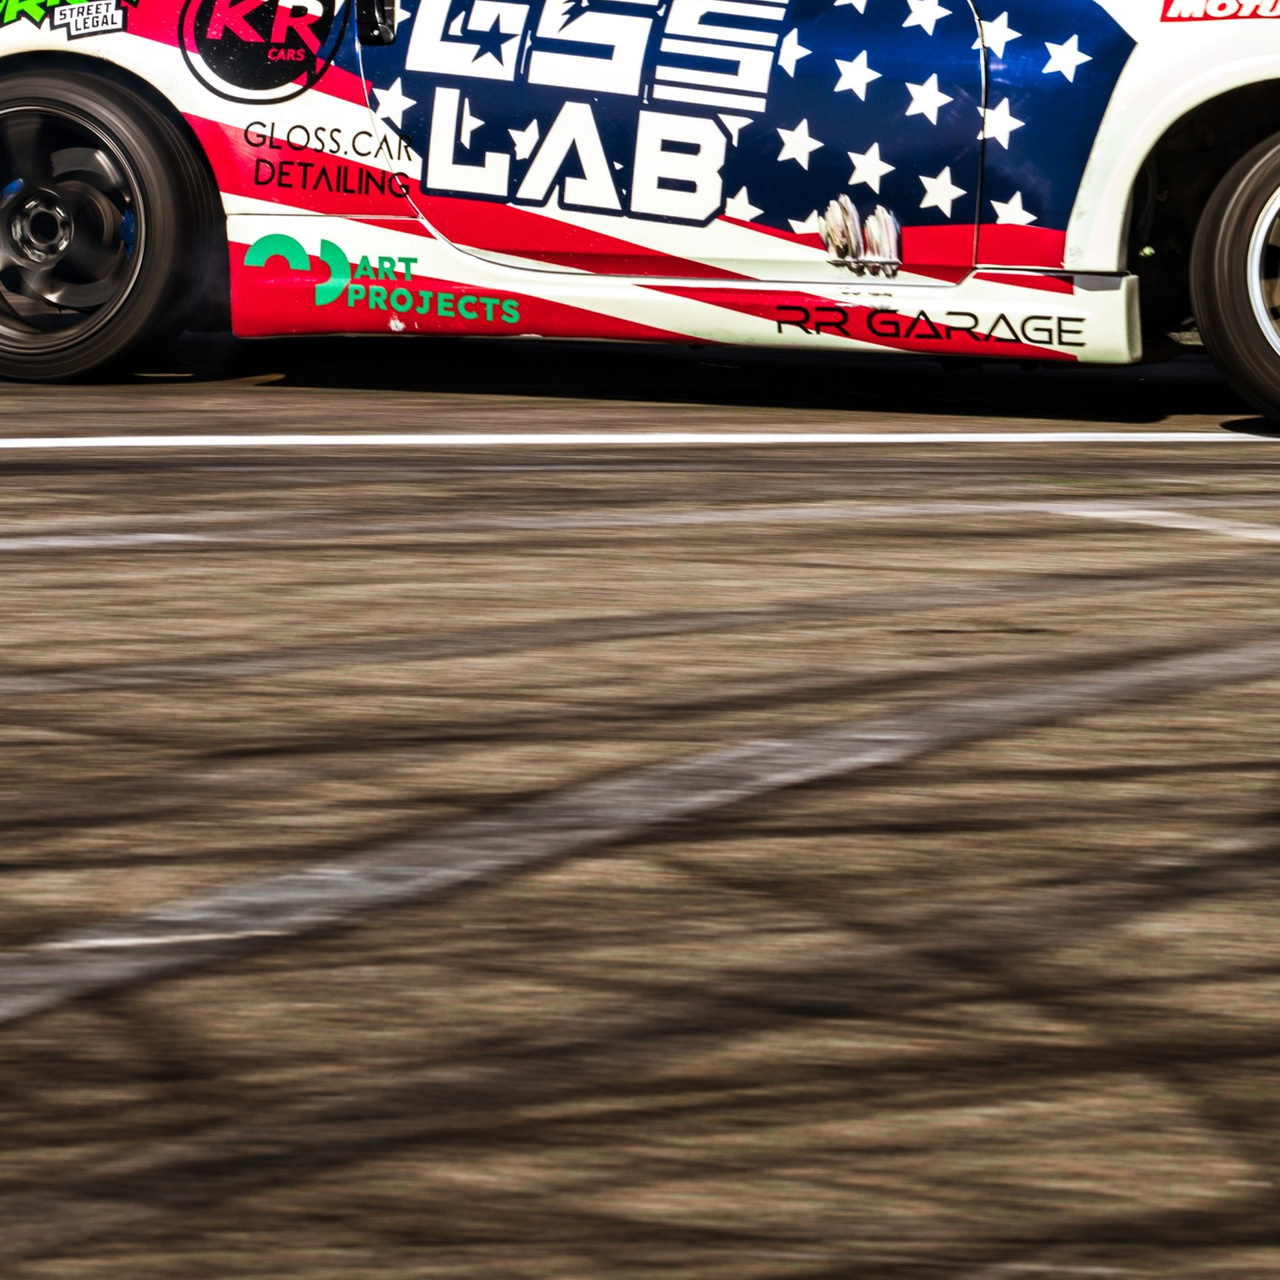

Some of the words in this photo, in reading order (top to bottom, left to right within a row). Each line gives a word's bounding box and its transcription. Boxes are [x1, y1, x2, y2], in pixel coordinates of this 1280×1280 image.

[59, 2, 112, 21] STREET
[74, 13, 118, 32] LEGAL
[267, 48, 306, 61] CARS
[244, 121, 413, 162] GLOSS.CAR
[427, 87, 728, 220] LAB
[254, 158, 411, 198] DETAILING
[353, 255, 418, 281] ART
[347, 284, 520, 324] PROJECTS
[776, 305, 850, 335] RR
[866, 309, 1087, 347] GARAGE
